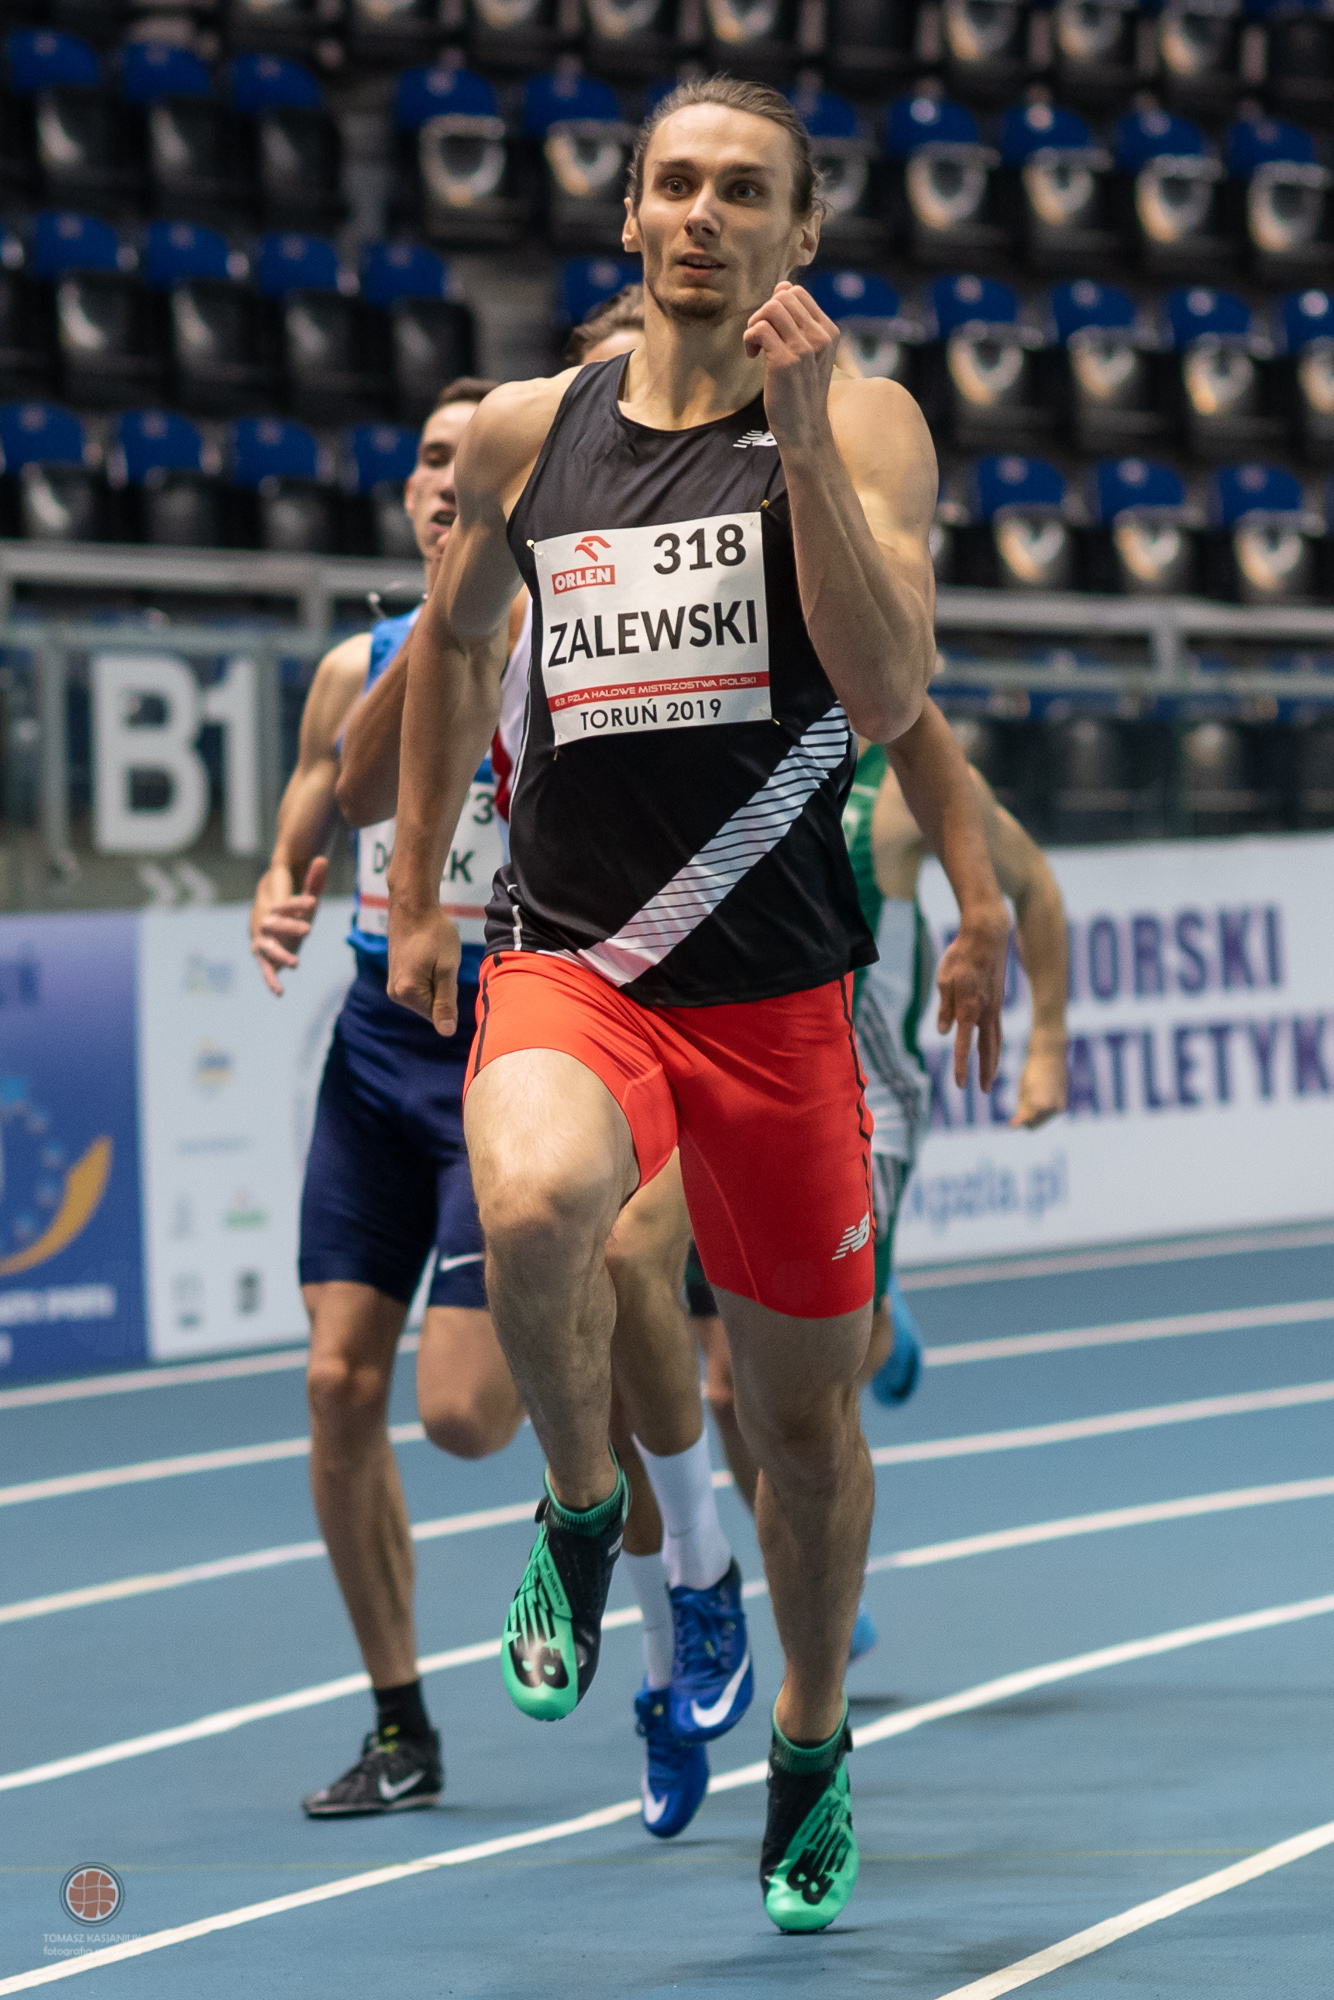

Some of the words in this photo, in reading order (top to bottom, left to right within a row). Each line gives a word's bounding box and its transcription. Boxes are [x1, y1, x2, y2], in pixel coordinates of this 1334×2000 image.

[653, 523, 747, 576] 318
[554, 566, 612, 592] ORLEN
[547, 599, 759, 668] ZALEWSKI
[567, 692, 590, 704] PZLA
[591, 686, 636, 700] HALOWE
[637, 679, 718, 694] MISTRZOSTWA
[718, 676, 757, 688] POLSKI
[580, 697, 659, 731] TORUŃ
[666, 698, 723, 723] 2019
[93, 654, 259, 855] B1
